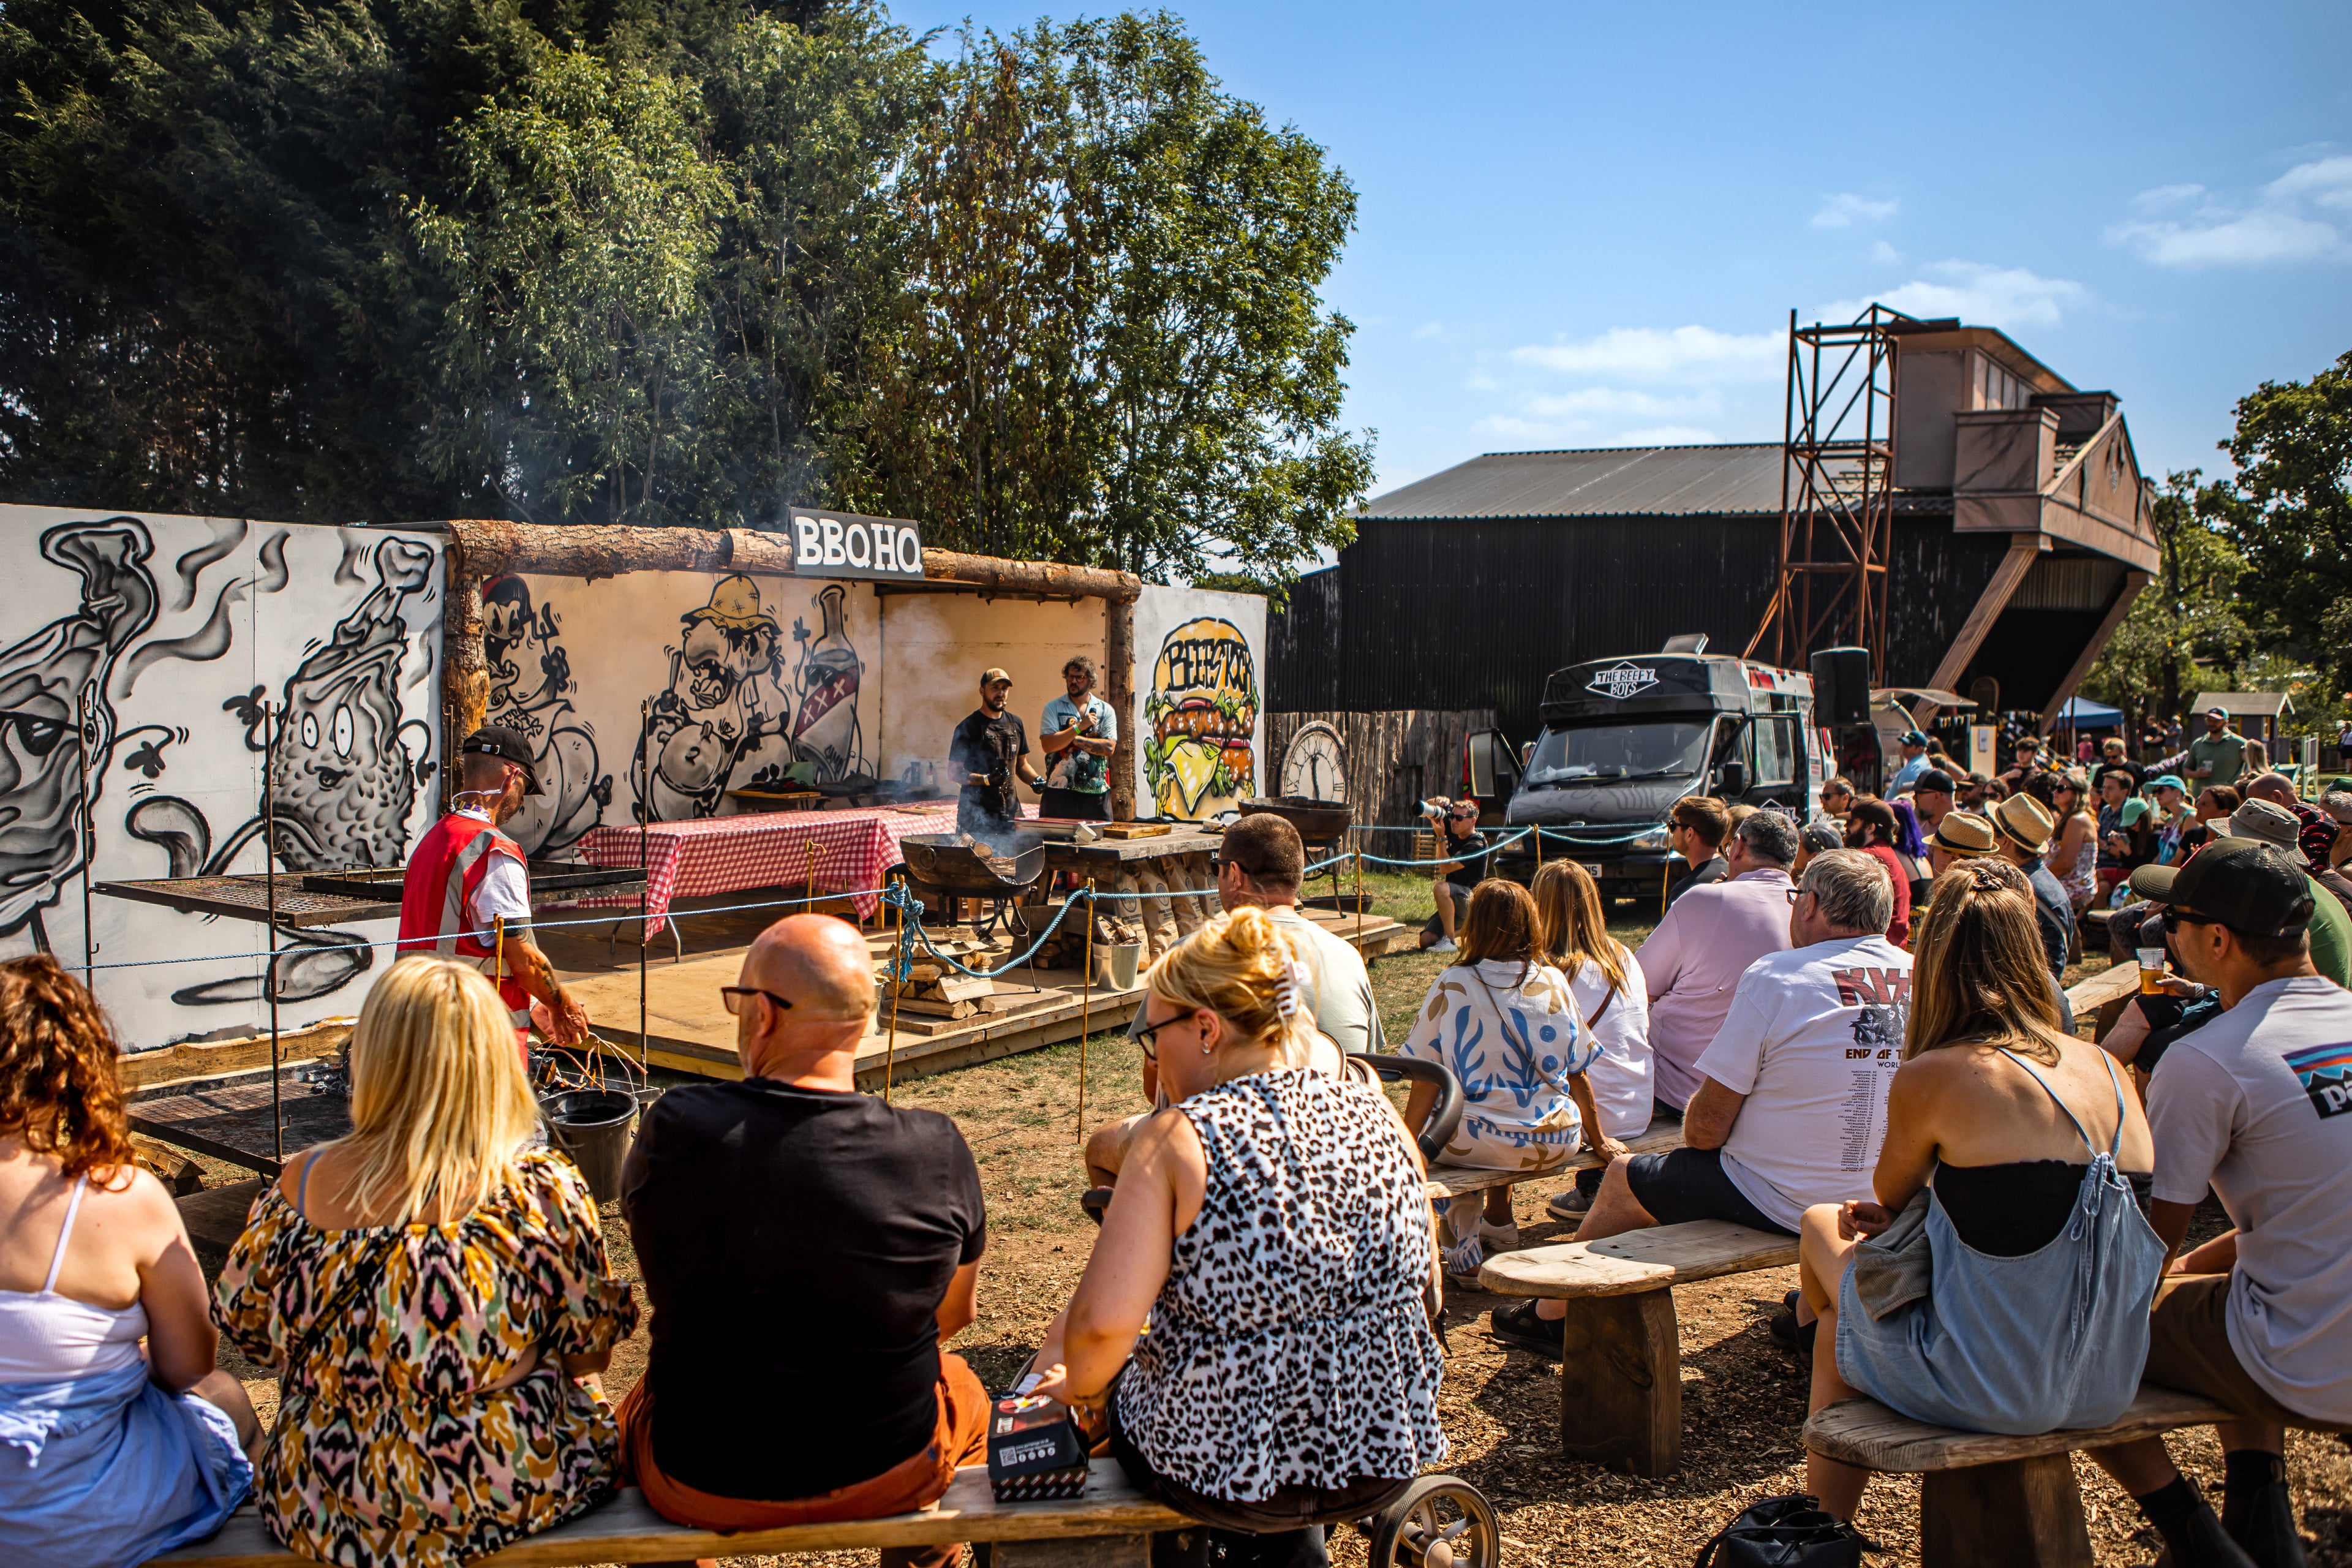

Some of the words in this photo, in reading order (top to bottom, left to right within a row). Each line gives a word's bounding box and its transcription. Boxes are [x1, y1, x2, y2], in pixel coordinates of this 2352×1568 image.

[1597, 671, 1618, 683] THE
[1620, 670, 1653, 681] BEEFY
[1610, 681, 1638, 696] BOYS
[1845, 1049, 1872, 1059] END
